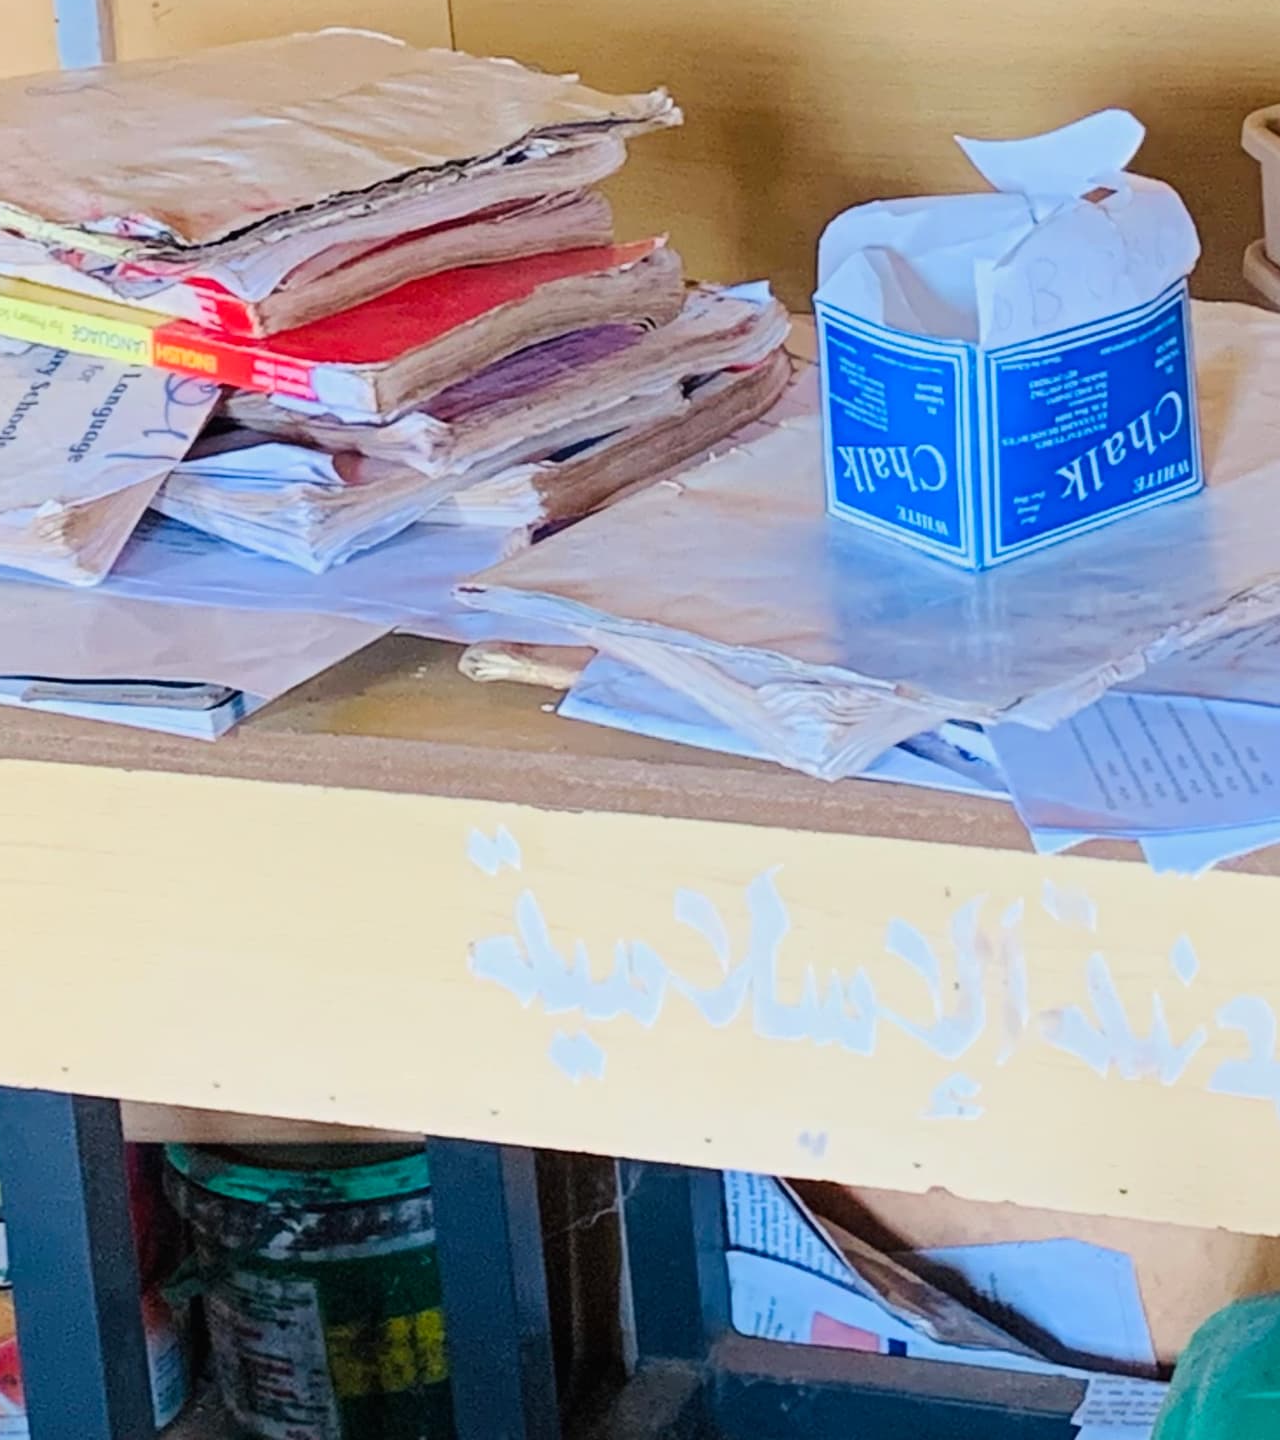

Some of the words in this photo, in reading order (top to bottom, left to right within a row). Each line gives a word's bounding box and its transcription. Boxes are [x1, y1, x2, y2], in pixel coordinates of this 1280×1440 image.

[72, 322, 149, 357] LANGUAGE
[156, 343, 218, 373] ENGLISH
[68, 372, 142, 463] Language
[1055, 390, 1183, 501] Chalk
[837, 444, 949, 494] Chalk
[1132, 459, 1190, 495] WHITE
[896, 504, 950, 536] WHITE
